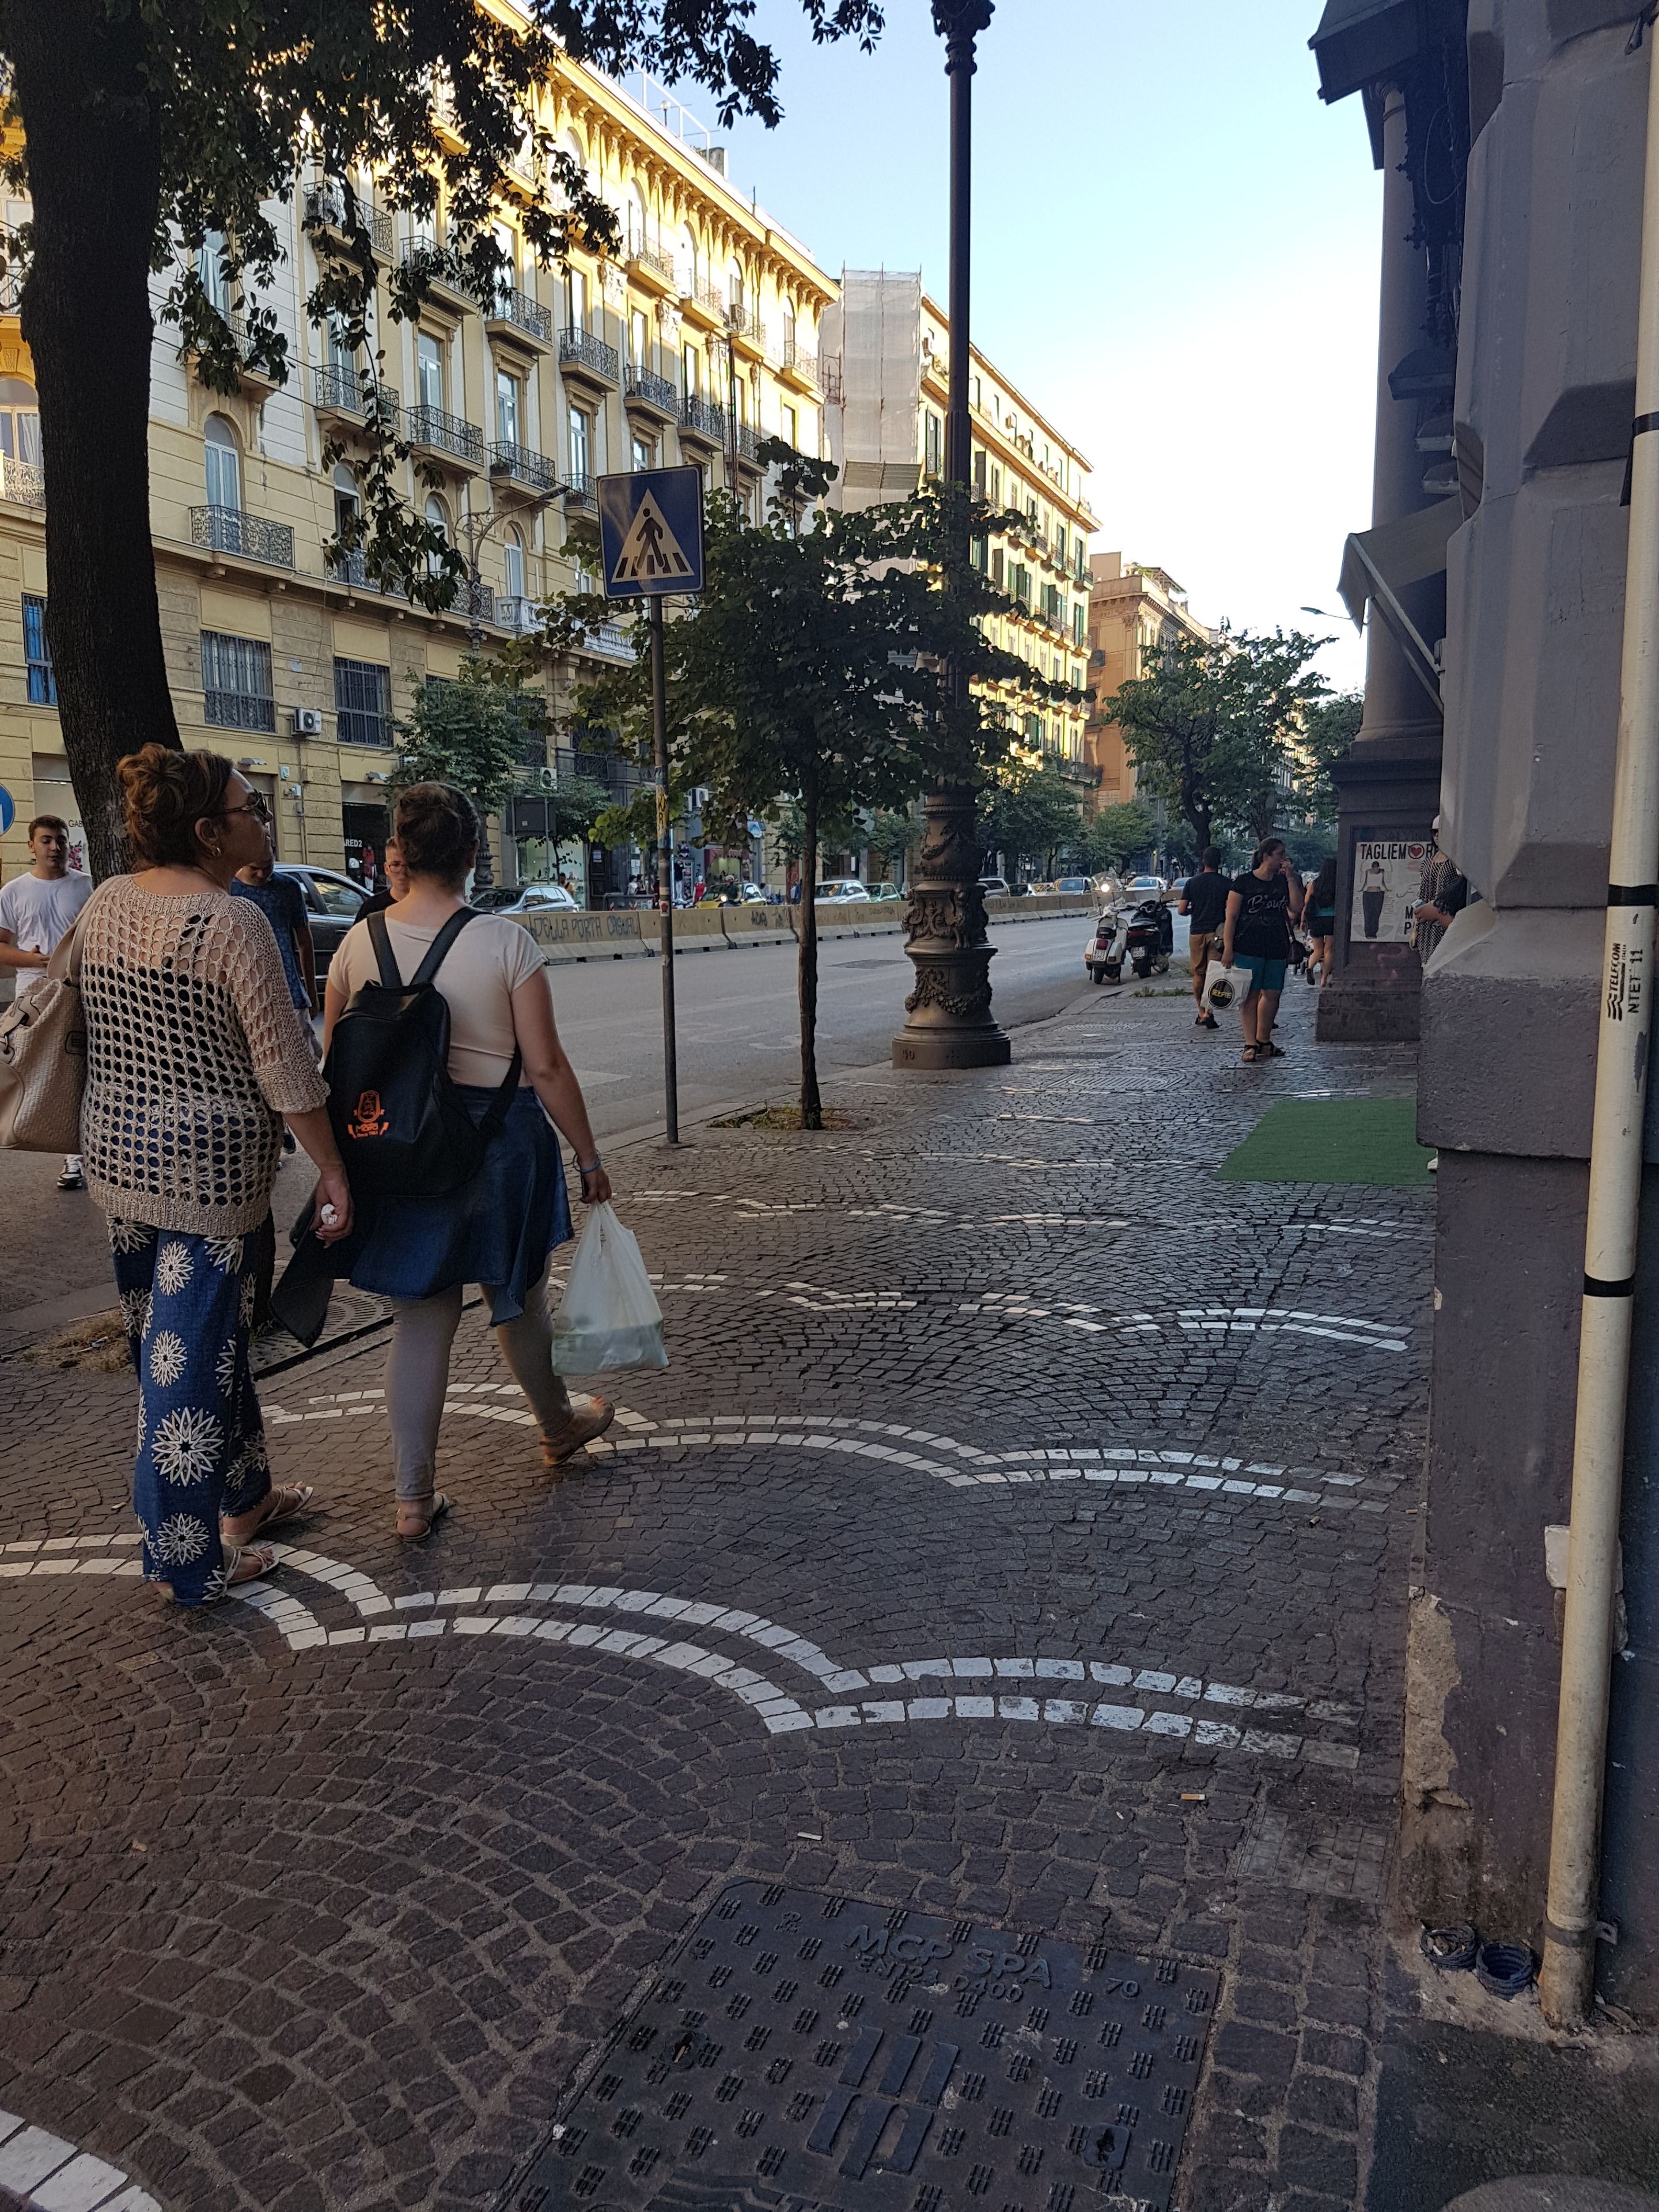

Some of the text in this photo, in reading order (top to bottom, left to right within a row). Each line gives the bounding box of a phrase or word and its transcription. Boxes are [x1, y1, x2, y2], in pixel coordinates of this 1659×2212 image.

[344, 839, 362, 847] RED2
[843, 1925, 1052, 1990] MCP SPA
